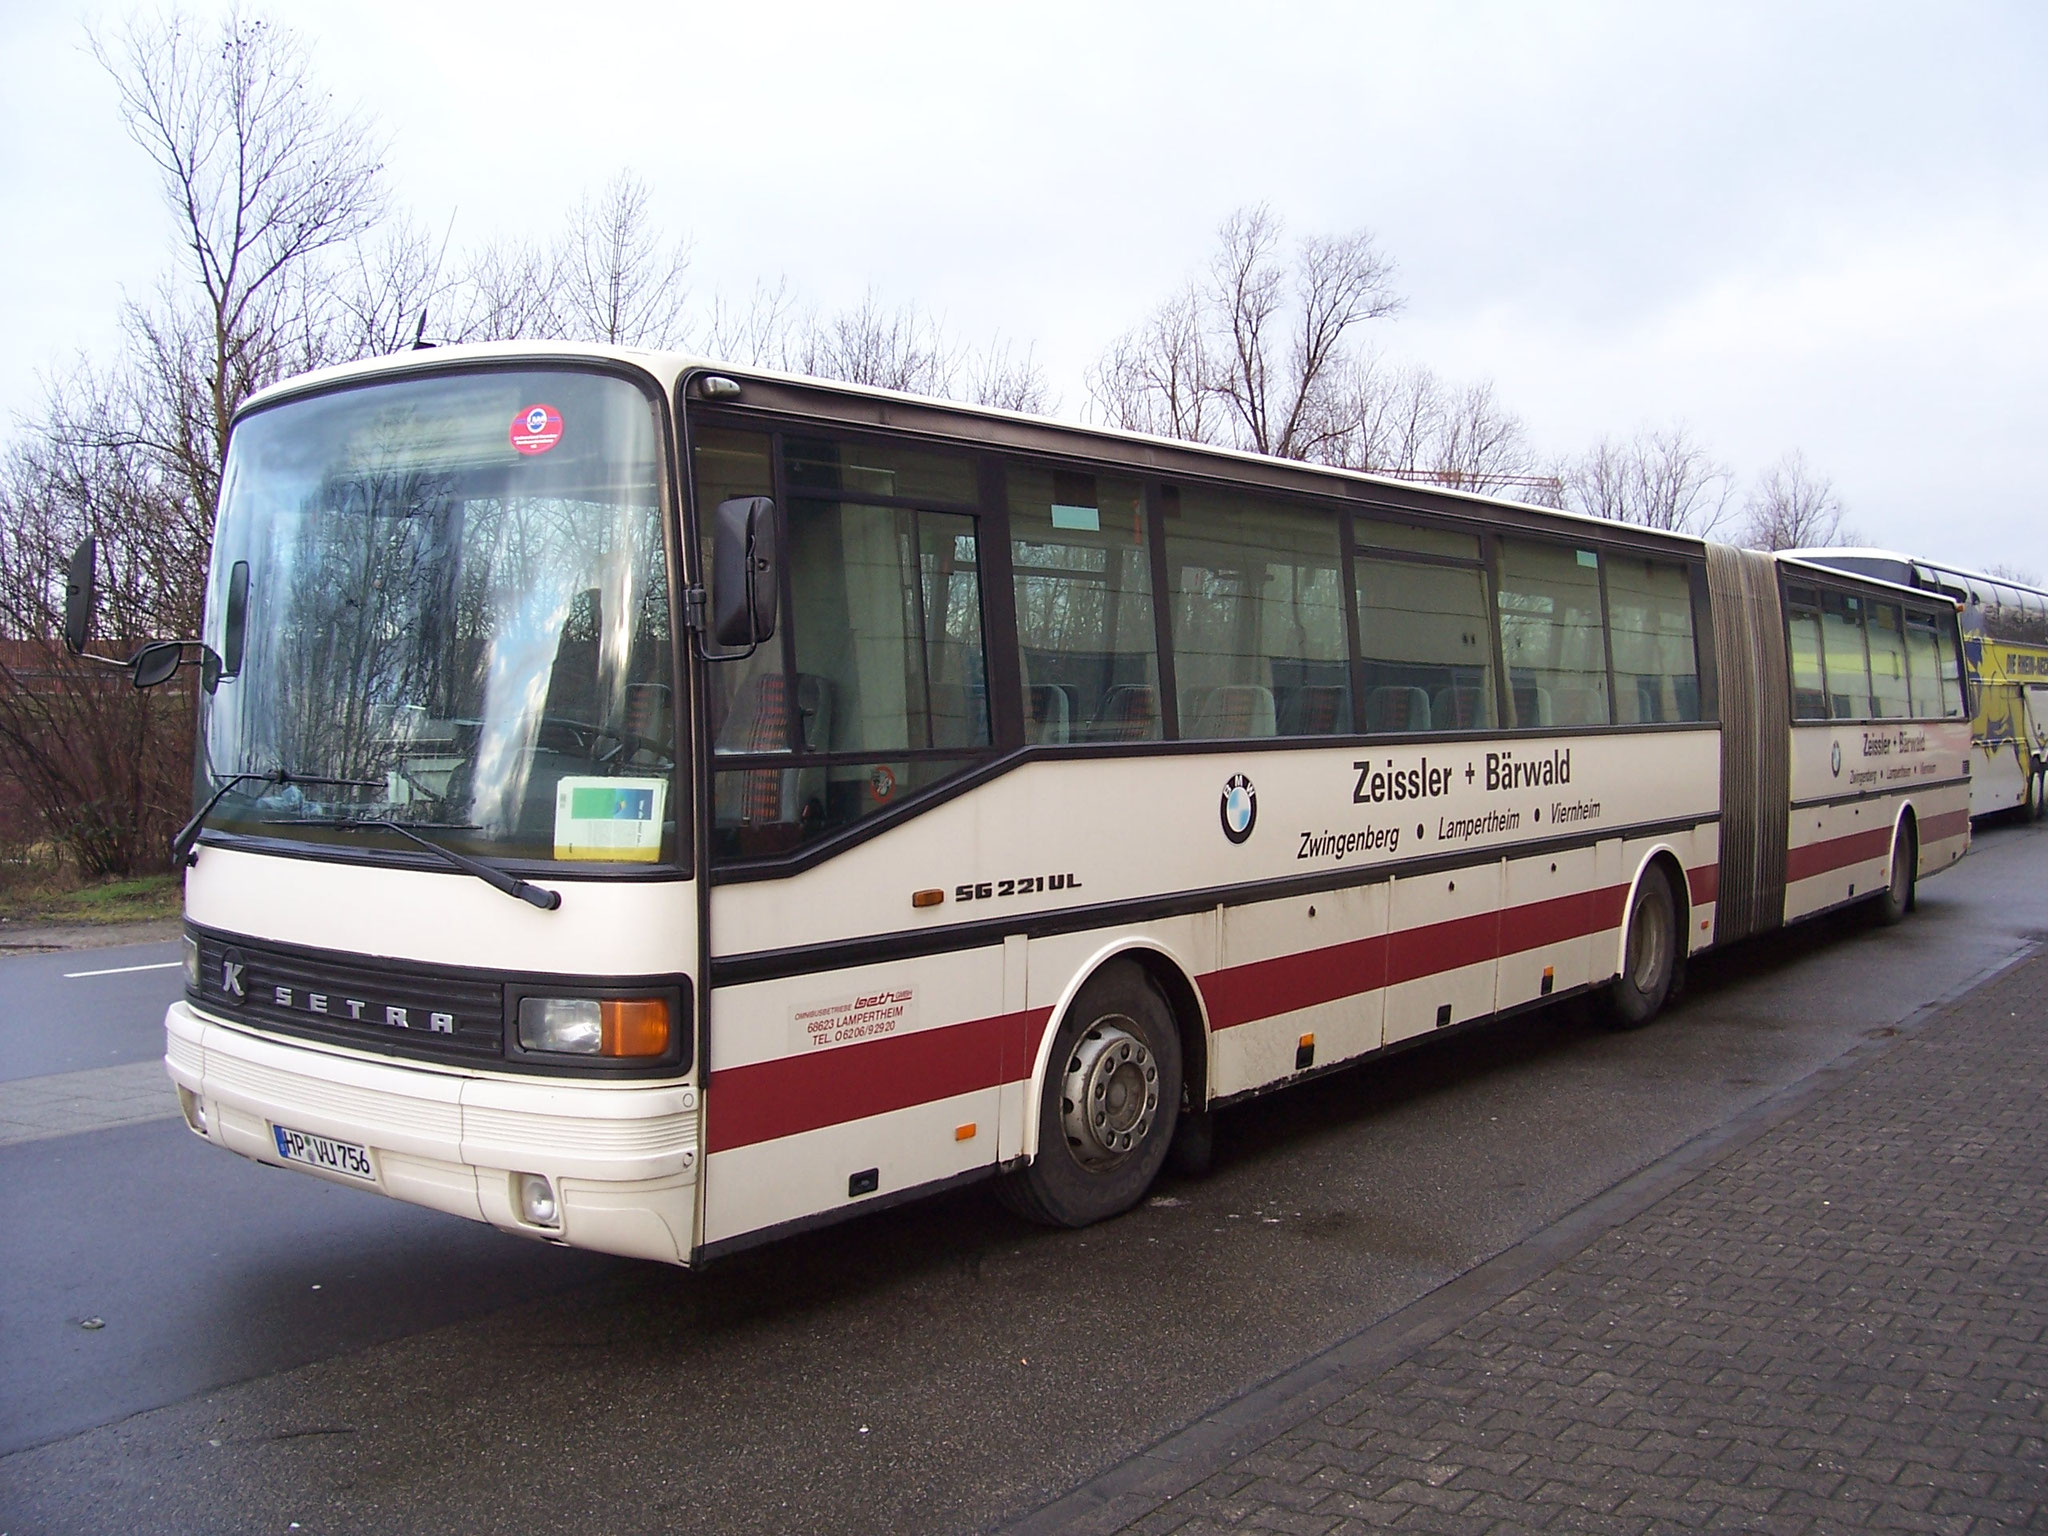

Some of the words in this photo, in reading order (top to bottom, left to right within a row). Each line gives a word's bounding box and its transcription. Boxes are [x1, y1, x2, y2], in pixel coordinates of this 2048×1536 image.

[1352, 757, 1452, 803] Zeissler
[1465, 762, 1475, 784] +
[1486, 748, 1570, 791] Bärwald
[1297, 824, 1400, 859] Zwingenberg
[1438, 808, 1520, 841] Lampertheim
[1551, 798, 1600, 824] Viernheim
[955, 882, 992, 902] SG
[997, 876, 1044, 897] 221
[1048, 873, 1082, 890] UL
[275, 986, 453, 1034] SETRA
[807, 1019, 834, 1033] 68623
[836, 1006, 903, 1028] LAMPERTHEIM
